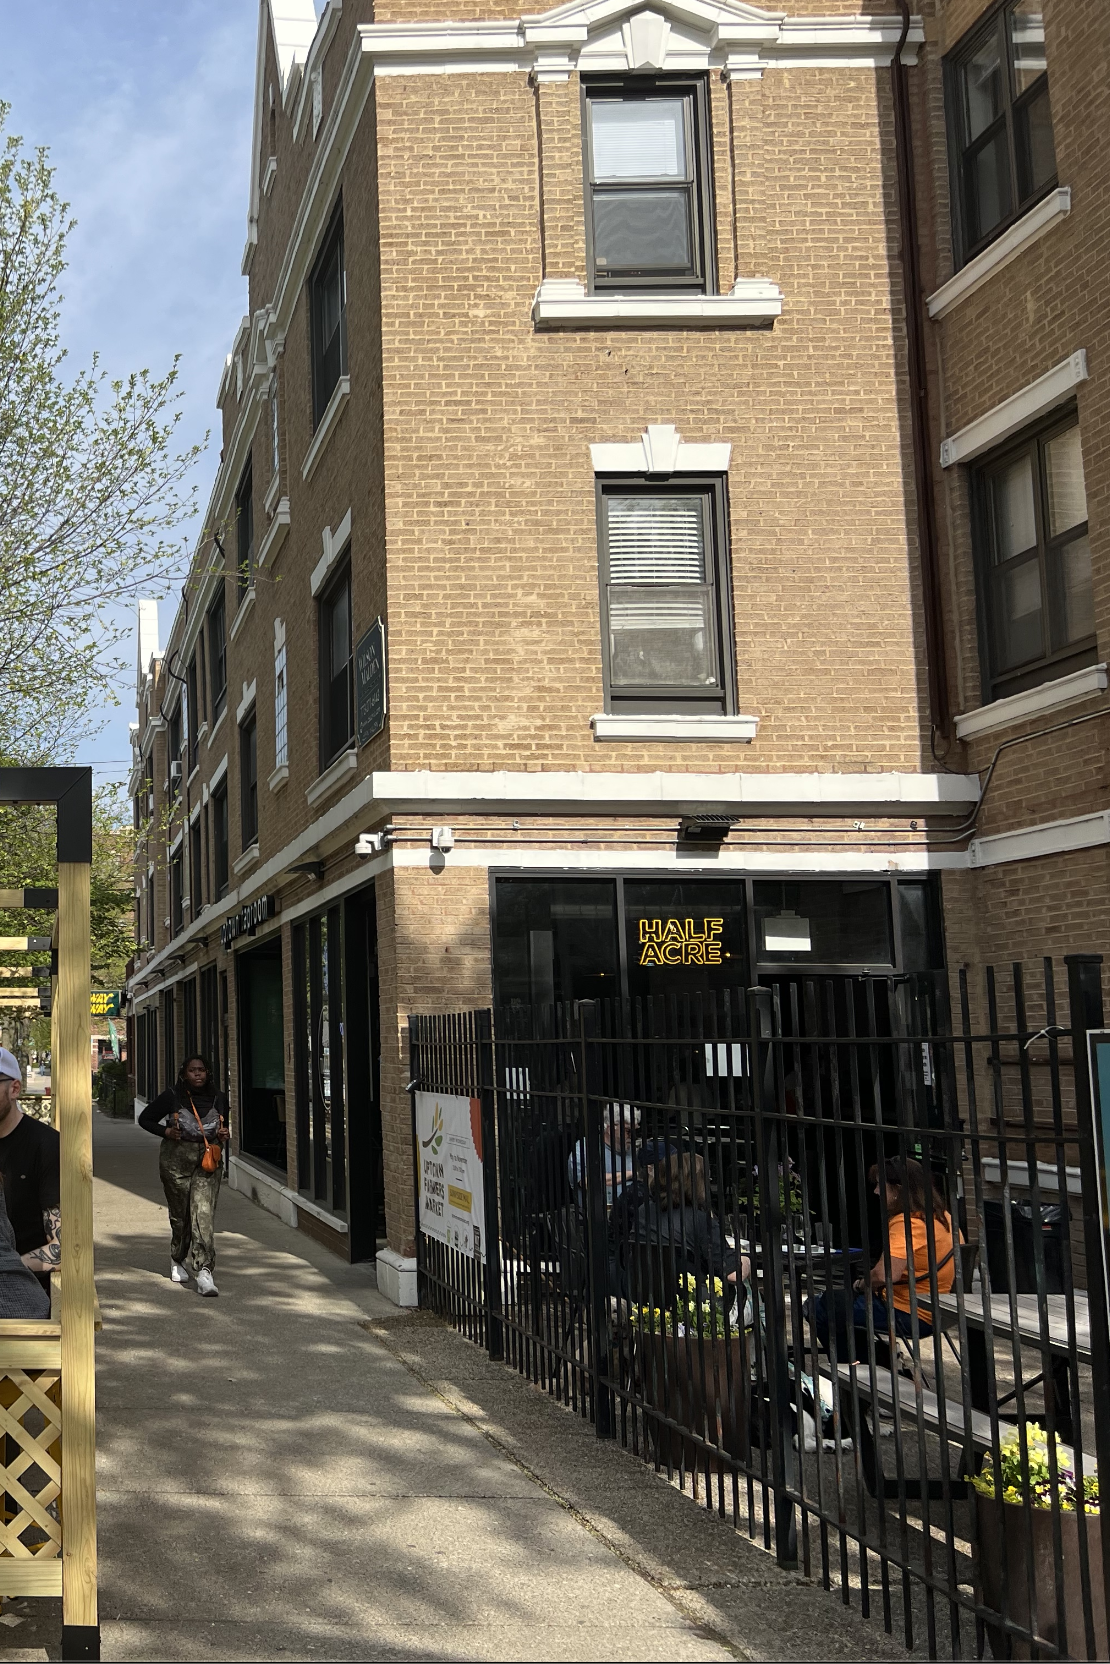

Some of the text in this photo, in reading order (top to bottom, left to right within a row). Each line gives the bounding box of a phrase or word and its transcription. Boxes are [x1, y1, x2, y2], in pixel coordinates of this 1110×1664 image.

[639, 918, 723, 942] HALF
[639, 941, 722, 965] ACRE
[424, 1159, 444, 1179] UPTOWN
[424, 1176, 445, 1200] FARMERS
[425, 1195, 444, 1217] MARKET
